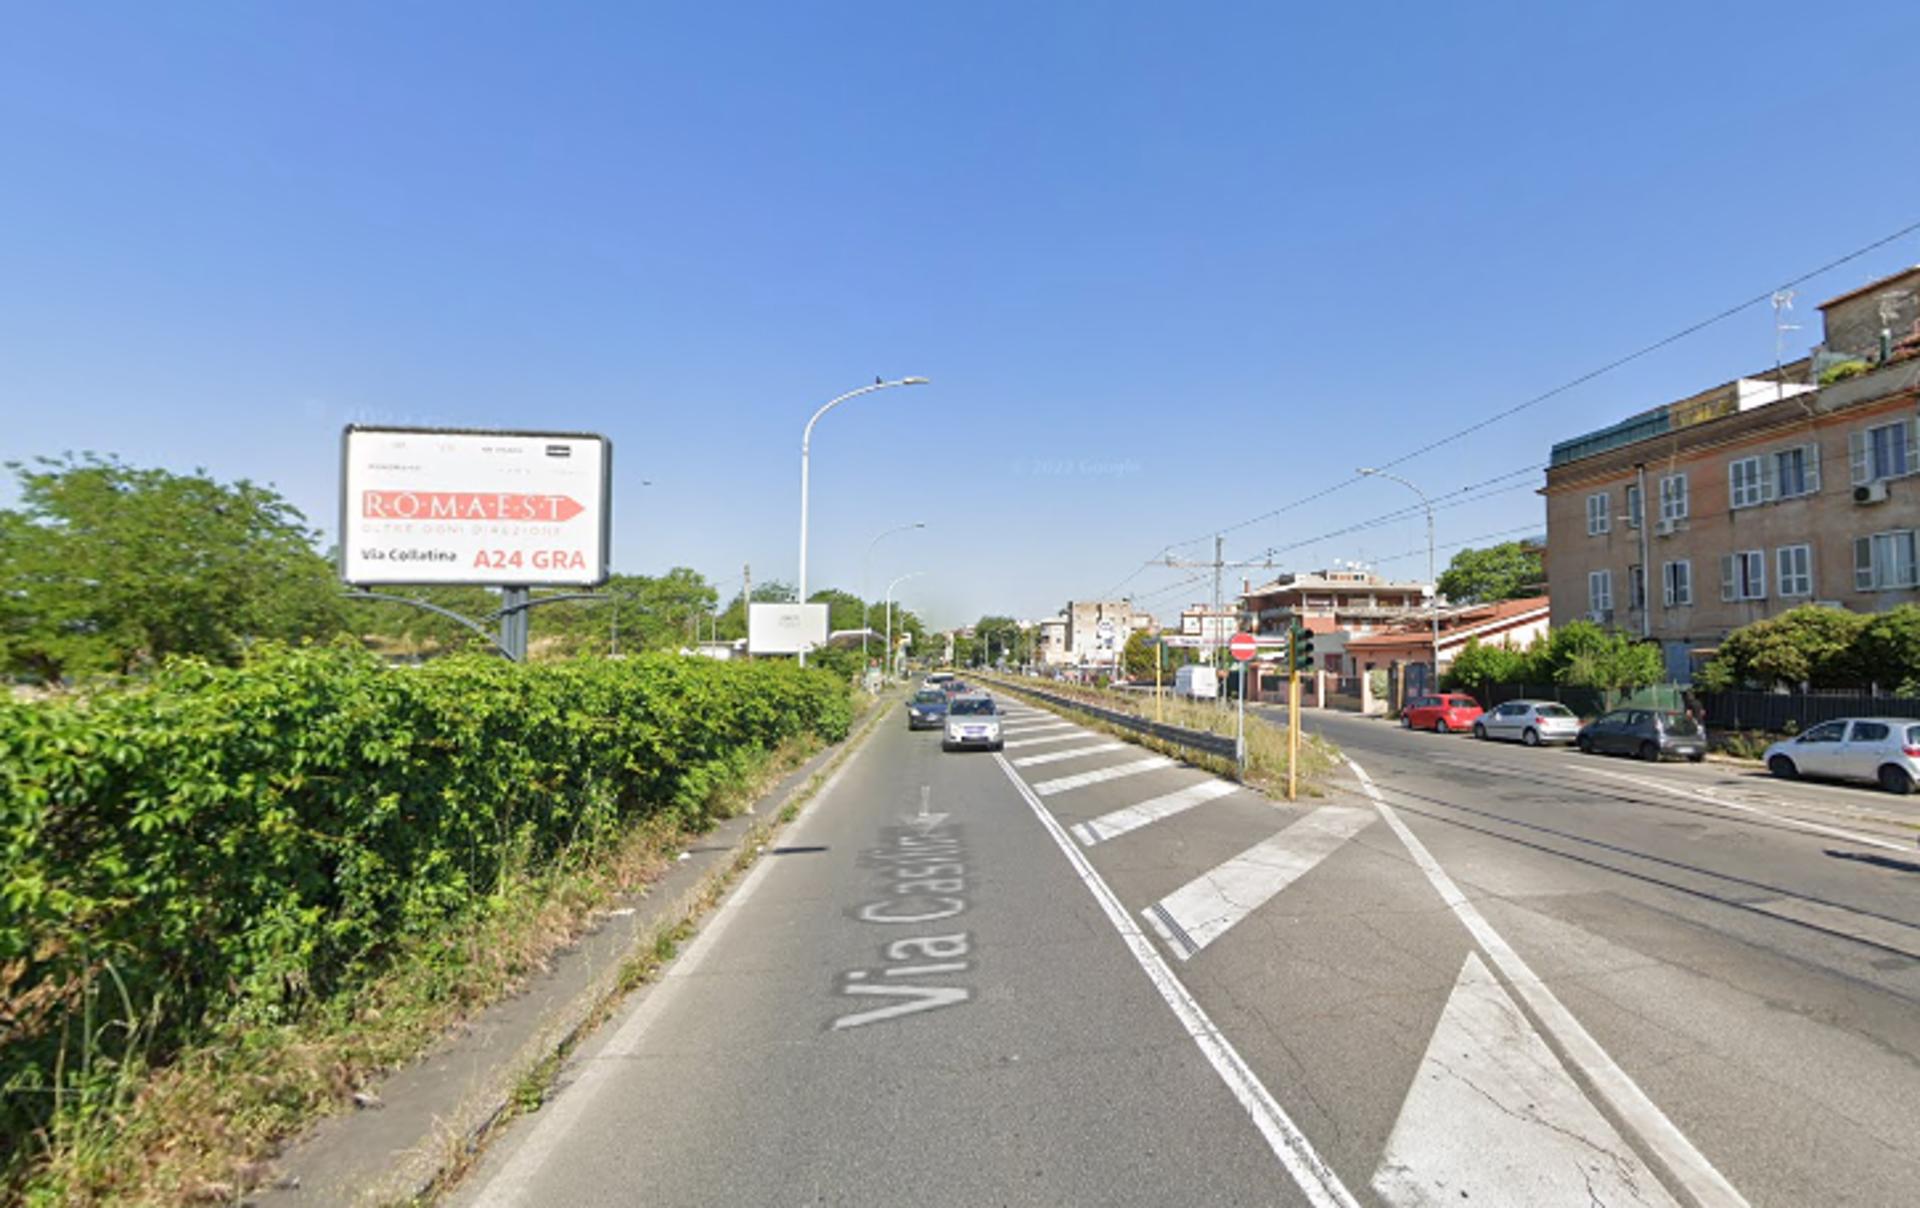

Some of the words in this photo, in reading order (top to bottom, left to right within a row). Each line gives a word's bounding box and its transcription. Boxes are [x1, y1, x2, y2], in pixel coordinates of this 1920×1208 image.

[361, 549, 386, 560] Via
[389, 549, 457, 562] Collatina
[473, 550, 523, 569] A24
[532, 550, 586, 570] GRA
[832, 933, 968, 1030] Via
